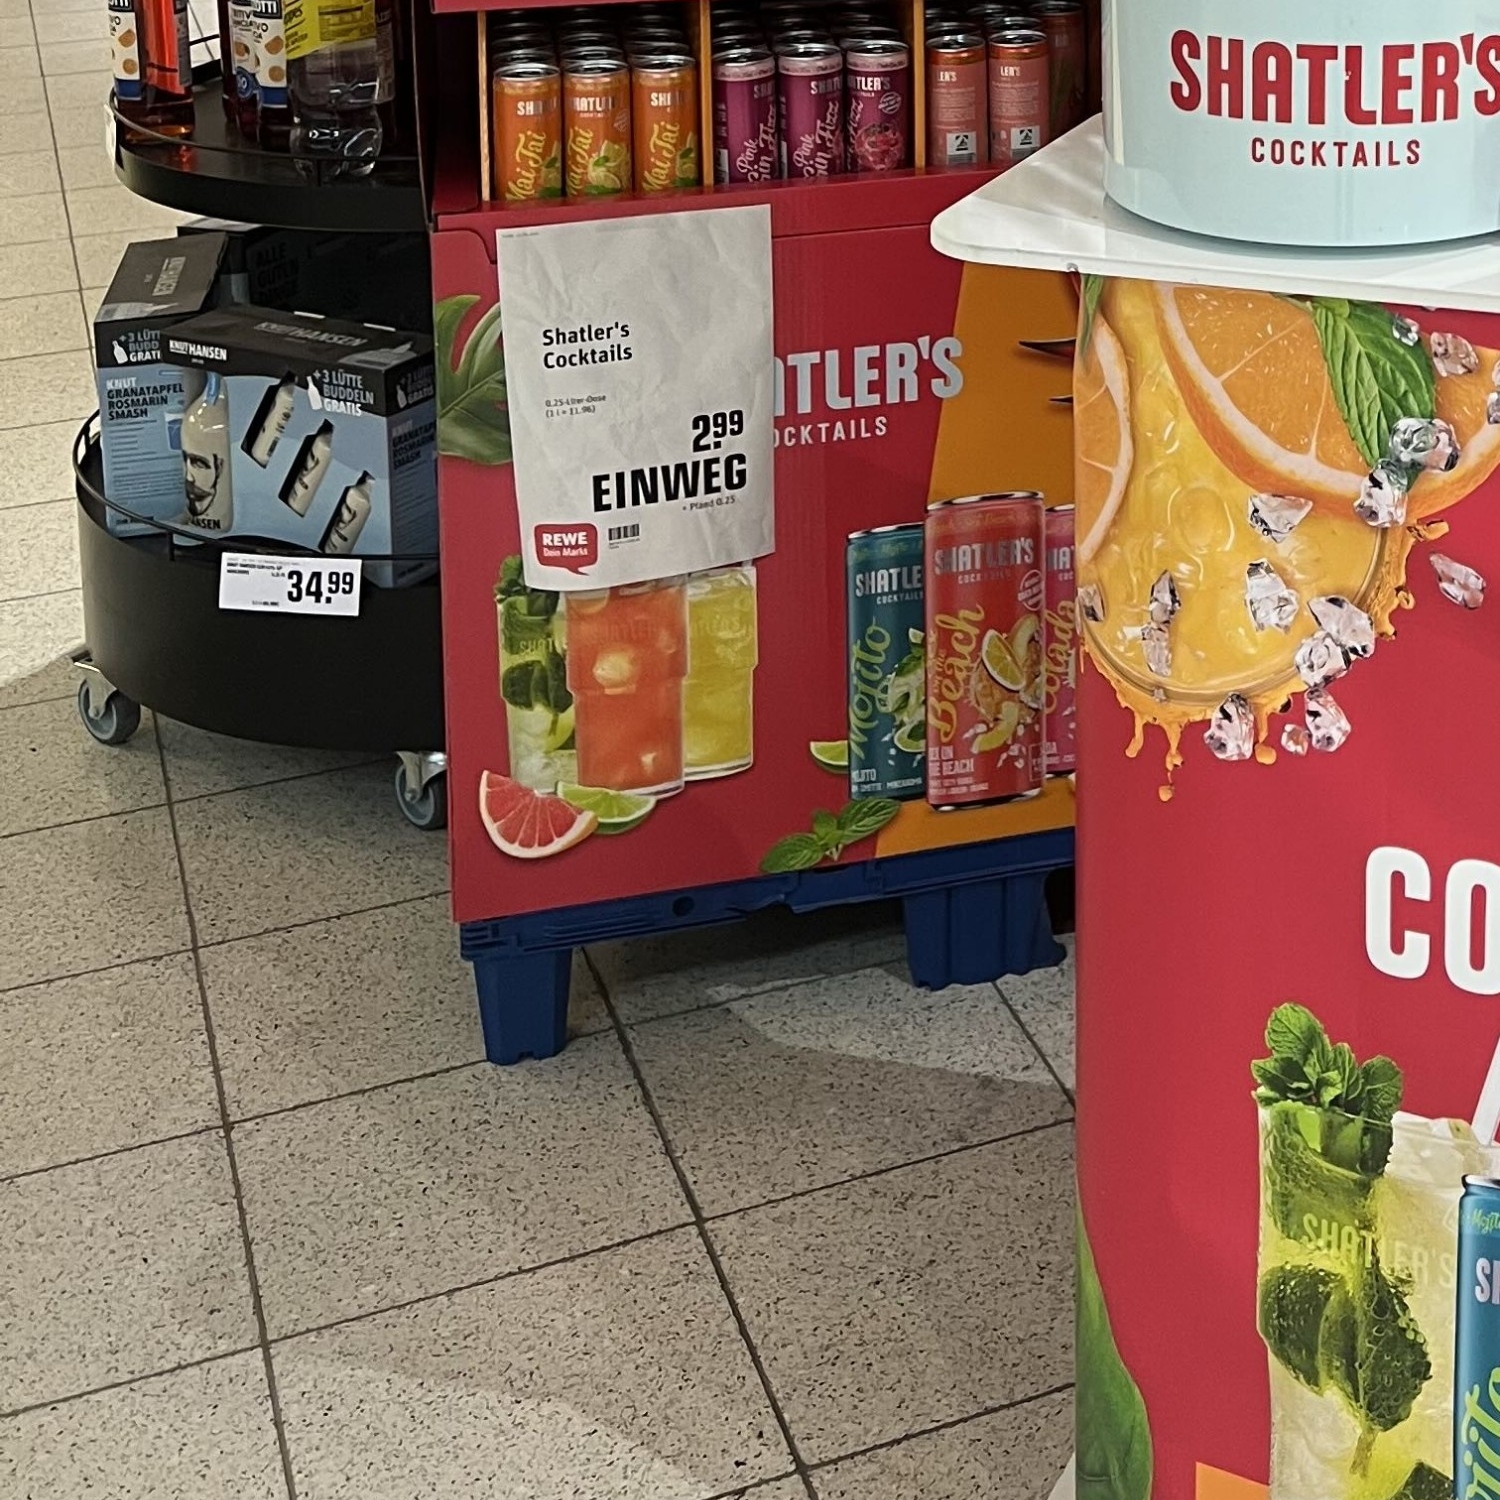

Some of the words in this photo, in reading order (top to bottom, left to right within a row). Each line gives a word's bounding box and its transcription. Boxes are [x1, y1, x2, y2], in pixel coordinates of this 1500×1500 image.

[1250, 138, 1421, 168] COCKTAILS
[542, 321, 630, 347] Shatler's
[543, 344, 633, 369] Cocktails
[332, 369, 363, 389] LÜTTE
[107, 383, 184, 400] GRANATAPFEL
[323, 383, 375, 405] BUDDELN
[108, 396, 169, 411] ROSMARIN
[108, 408, 149, 421] SMASH
[323, 398, 363, 417] GRATIS
[692, 409, 744, 453] 2.99
[592, 453, 747, 513] EINWEG
[542, 532, 588, 547] REWE
[287, 570, 354, 604] 34.99
[927, 603, 985, 742] Beach
